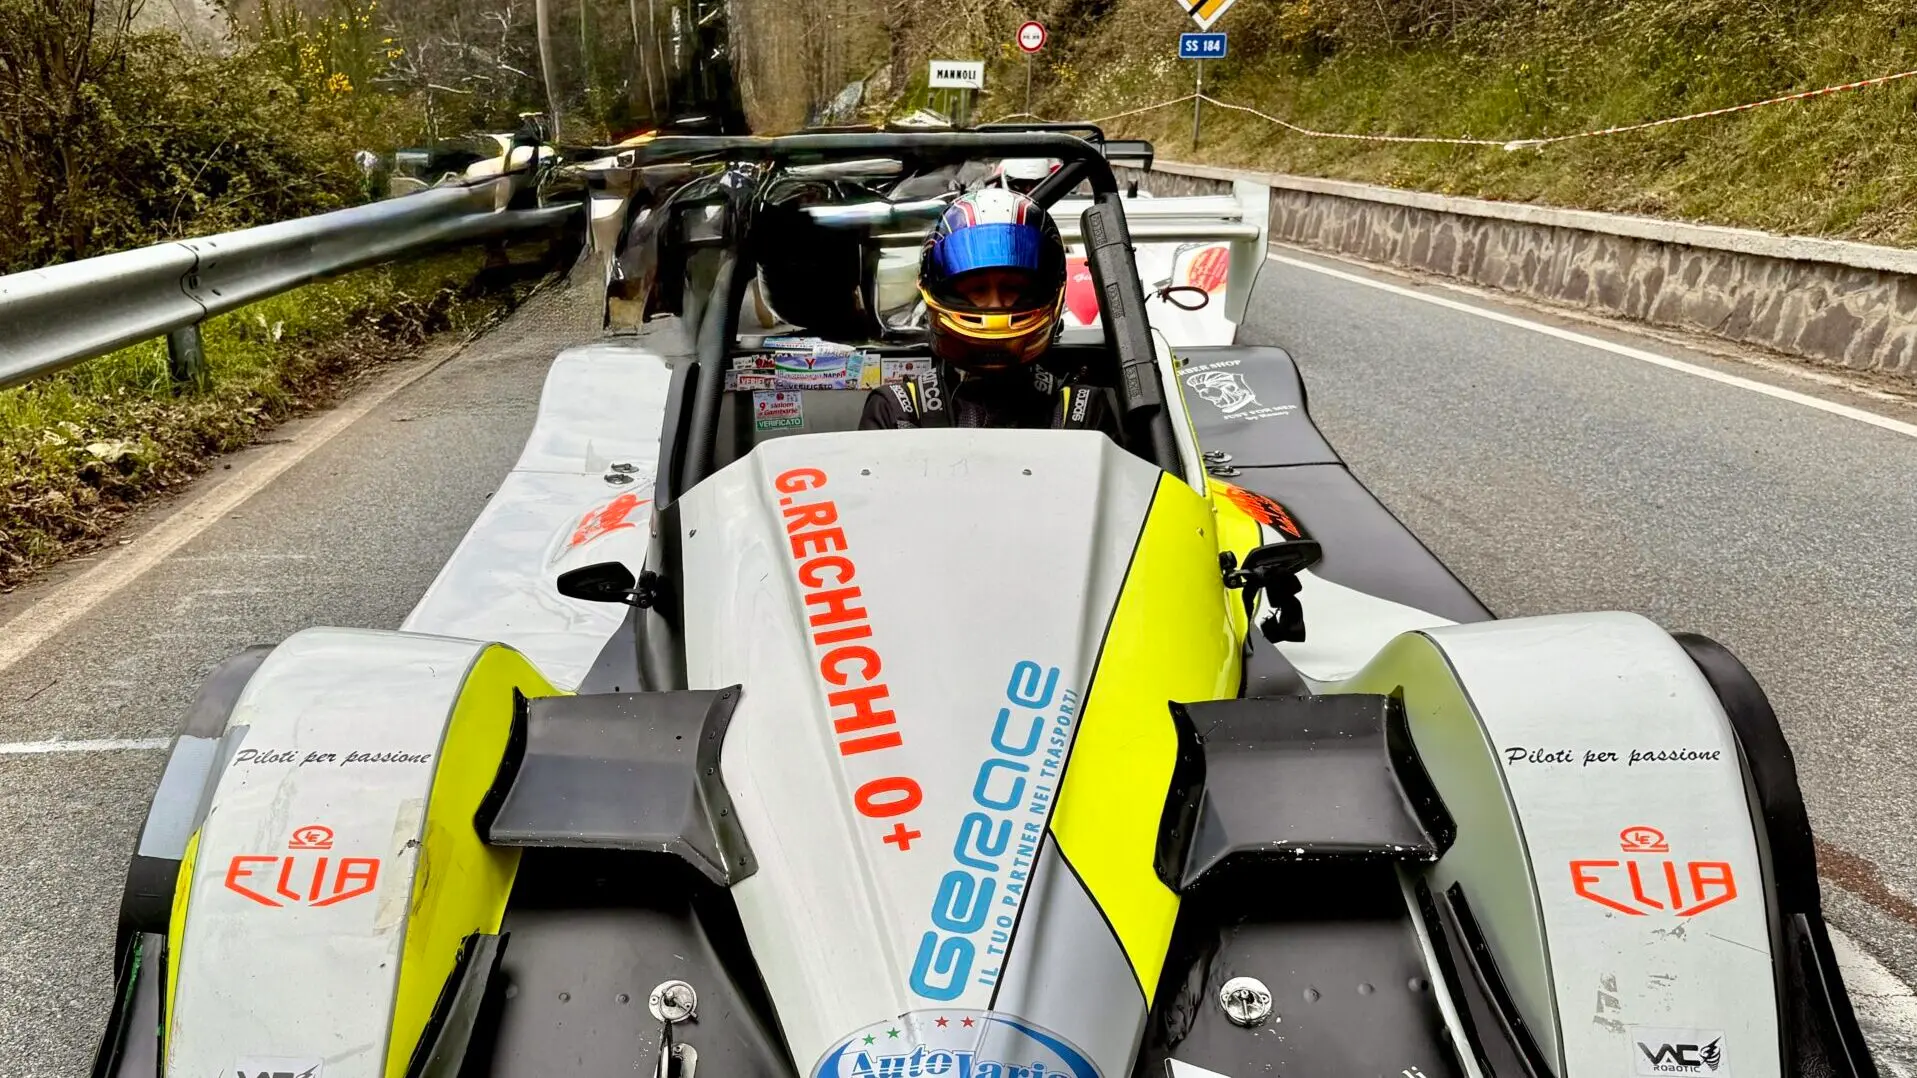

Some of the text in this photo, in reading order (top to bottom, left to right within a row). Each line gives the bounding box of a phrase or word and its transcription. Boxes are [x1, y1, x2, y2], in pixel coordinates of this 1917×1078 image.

[1185, 39, 1221, 52] SS 184
[936, 69, 977, 80] MANNOLI
[1072, 388, 1091, 422] sparco
[759, 418, 801, 429] VERIFICATO
[775, 467, 903, 756] G.RECHICHI
[233, 748, 432, 767] Piloti per passione
[1504, 747, 1721, 767] Piloti per passione
[978, 688, 1079, 986] IL TUO PARTNER NEI TRASPORTI
[224, 855, 380, 907] ELIA
[1569, 860, 1738, 917] ELIA
[1653, 1065, 1702, 1073] ROBOTIC
